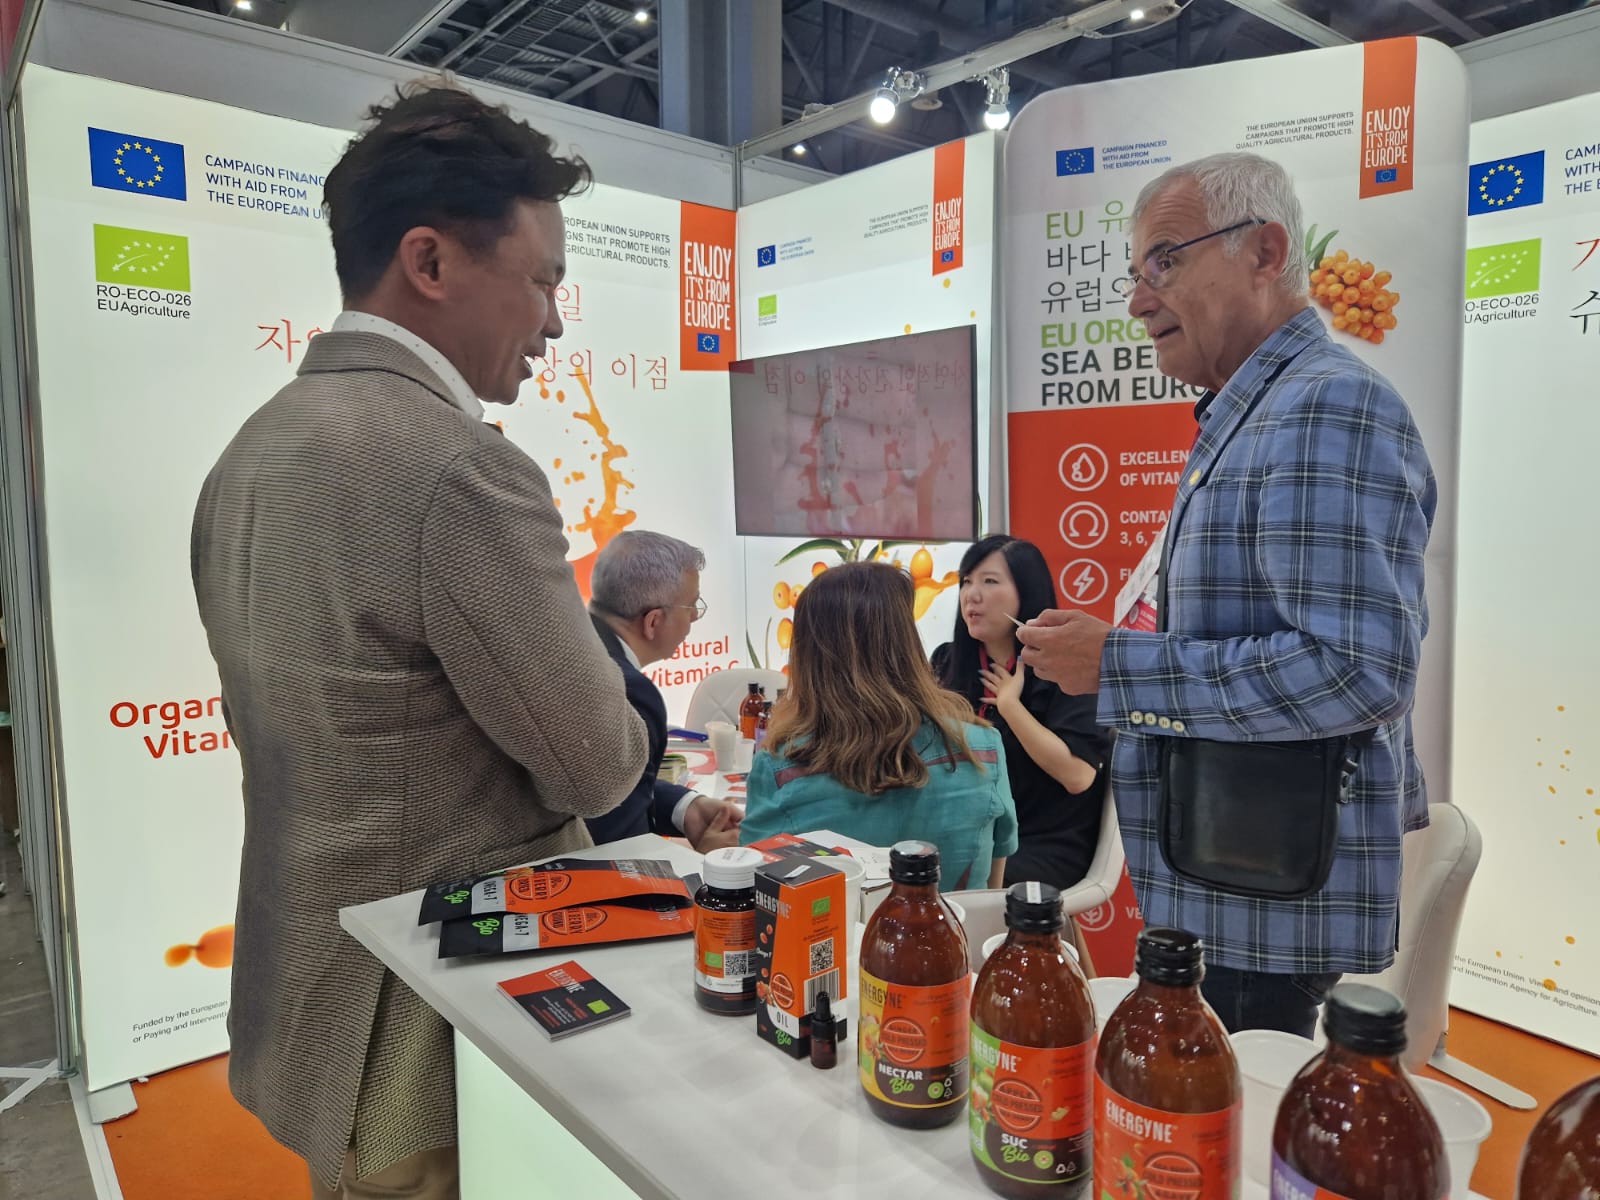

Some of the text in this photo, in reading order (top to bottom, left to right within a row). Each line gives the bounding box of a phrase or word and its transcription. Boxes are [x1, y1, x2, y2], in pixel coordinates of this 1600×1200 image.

[1245, 119, 1354, 140] CAMPAIGNS THAT PROMOTE HIGH
[1260, 119, 1296, 130] EUROPEAN
[1296, 115, 1318, 125] UNION
[1318, 111, 1354, 122] SUPPORTS
[1365, 105, 1411, 133] ENJOY
[1102, 139, 1167, 154] CAMPAIGN FINANCED
[1235, 140, 1263, 150] QUALITY
[1264, 133, 1314, 146] AGRICULTURAL
[1366, 129, 1408, 149] IT'S FROM
[205, 154, 275, 178] CAMPAIGN
[1102, 150, 1149, 162] WITH AID FROM
[1115, 158, 1150, 169] EUROPEAN
[1150, 156, 1171, 165] UNION
[1365, 145, 1408, 169] EUROPE
[1564, 161, 1600, 178] WITH
[205, 172, 307, 201] WITH AID FROM
[1564, 180, 1592, 195] THE
[207, 189, 325, 220] THE EUROPEAN U
[935, 196, 962, 222] ENJOY
[600, 223, 627, 236] UNION
[628, 228, 670, 244] SUPPORTS
[946, 216, 961, 233] FROM
[1046, 209, 1084, 240] EU
[586, 233, 607, 247] THAT
[609, 238, 650, 254] PROMOTE
[651, 246, 671, 257] HIGH
[935, 231, 961, 251] EUROPE
[683, 241, 732, 281] ENJOY
[1047, 240, 1111, 276] 바다
[96, 284, 192, 307] RO-ECO-026
[685, 275, 730, 304] IT'S FROM
[684, 300, 731, 331] EUROPE
[255, 318, 324, 364] 자
[1041, 317, 1152, 348] EU ORG
[611, 352, 668, 391] 이점
[1041, 345, 1159, 376] SEA BE
[1041, 378, 1120, 407] FROM
[1119, 449, 1190, 466] EXCELLEN
[1119, 473, 1138, 487] OF
[1119, 531, 1132, 547] 3,
[1135, 531, 1148, 547] 6,
[664, 635, 729, 661] atural
[1509, 982, 1538, 998] Agency
[132, 1016, 164, 1031] Funded
[164, 1013, 175, 1023] by
[176, 1011, 190, 1019] the
[776, 1011, 789, 1028] OIL
[132, 1036, 142, 1044] or
[143, 1026, 172, 1040] Paying
[173, 1021, 188, 1031] and
[971, 1034, 1017, 1073] NERGYNE
[878, 1063, 923, 1081] NECTAR
[889, 1078, 916, 1095] Bio
[1105, 1098, 1173, 1144] ENERGYNE
[1001, 1133, 1028, 1150] SUC
[1001, 1144, 1030, 1164] Bio
